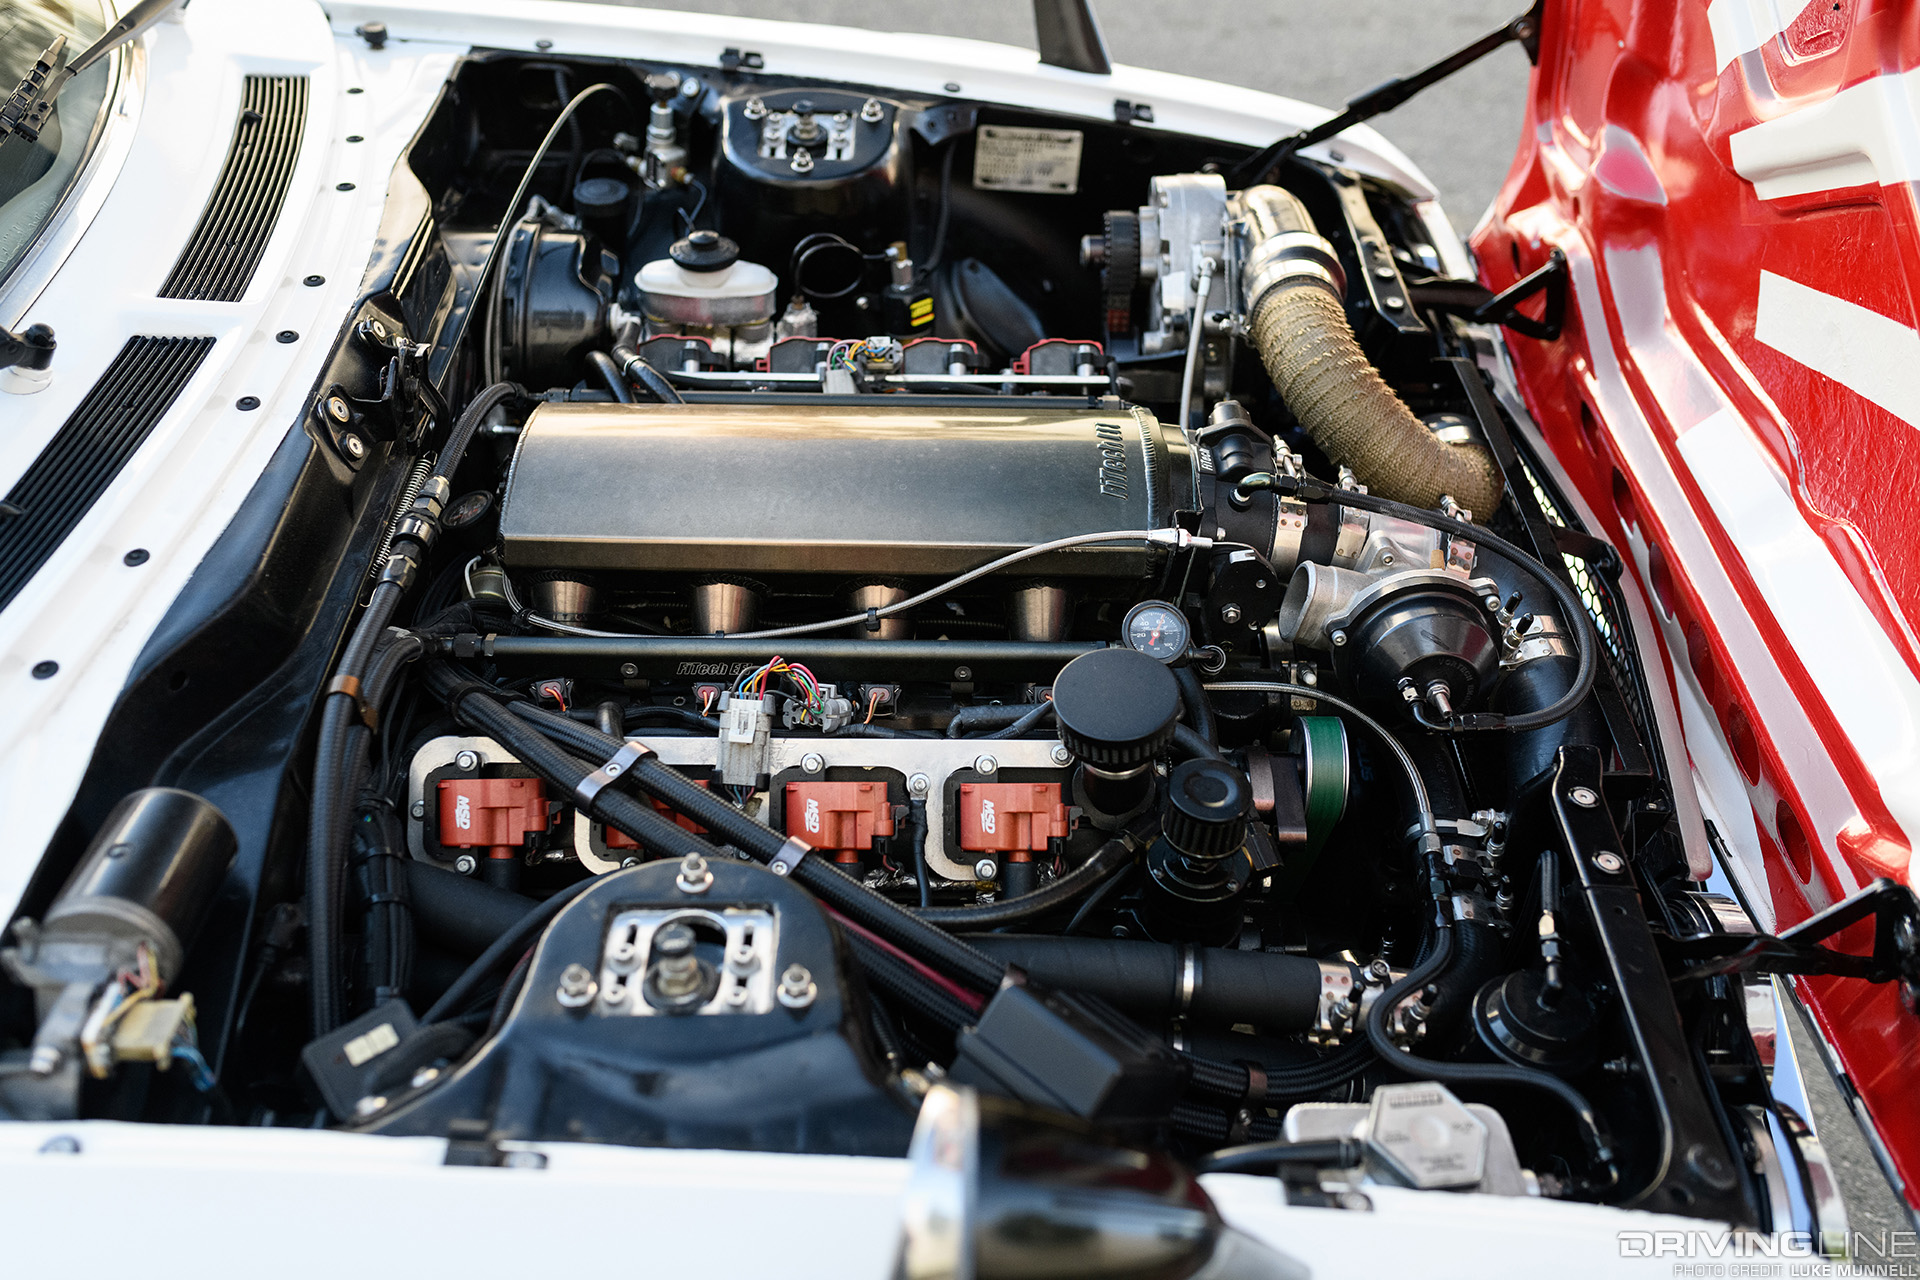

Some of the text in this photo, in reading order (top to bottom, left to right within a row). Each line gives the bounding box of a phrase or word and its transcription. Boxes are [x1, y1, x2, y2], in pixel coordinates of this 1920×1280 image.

[676, 662, 728, 675] FiTech
[455, 795, 470, 830] MSD
[804, 798, 820, 833] MSD
[981, 799, 996, 834] MSD
